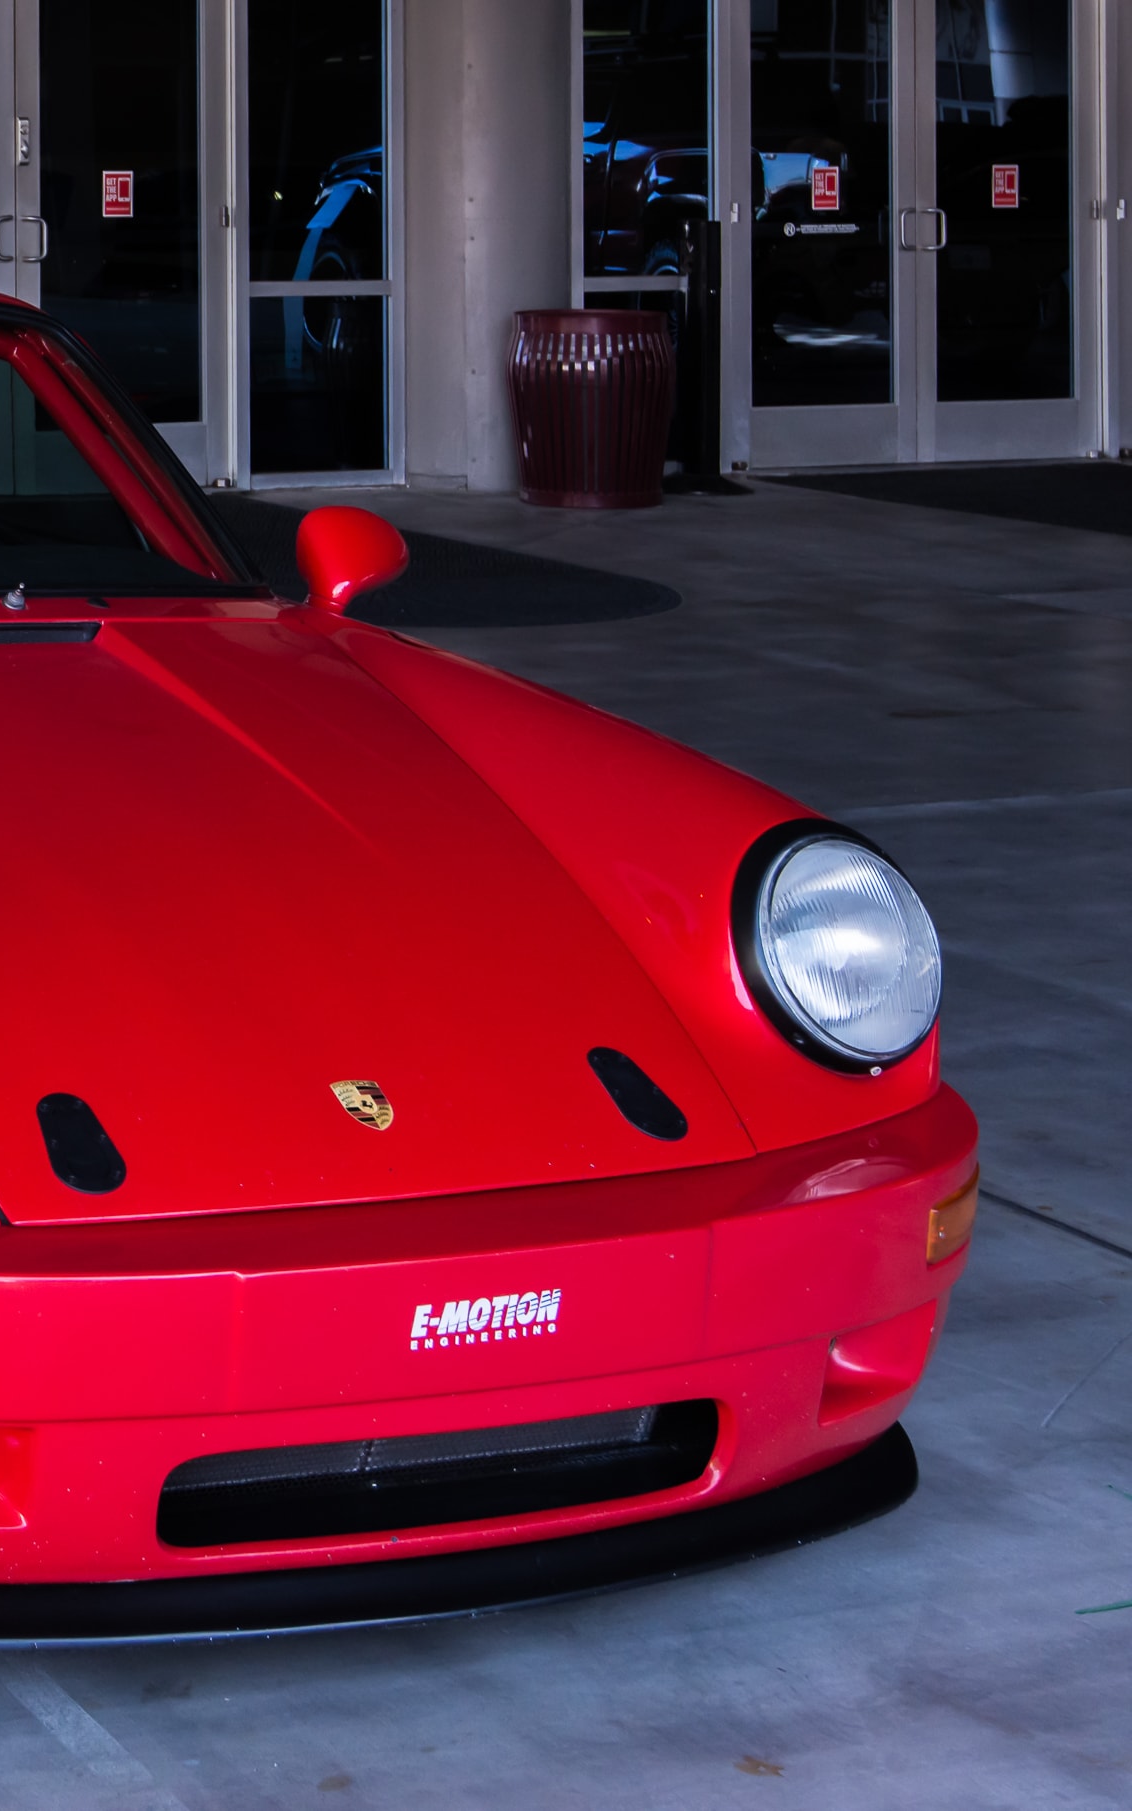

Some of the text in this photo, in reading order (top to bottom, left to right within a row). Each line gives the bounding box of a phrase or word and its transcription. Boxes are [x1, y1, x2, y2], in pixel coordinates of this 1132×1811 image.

[107, 177, 116, 185] GET
[106, 194, 117, 202] APP
[410, 1288, 562, 1339] E-MOTION
[409, 1322, 558, 1351] ENGINEERING
